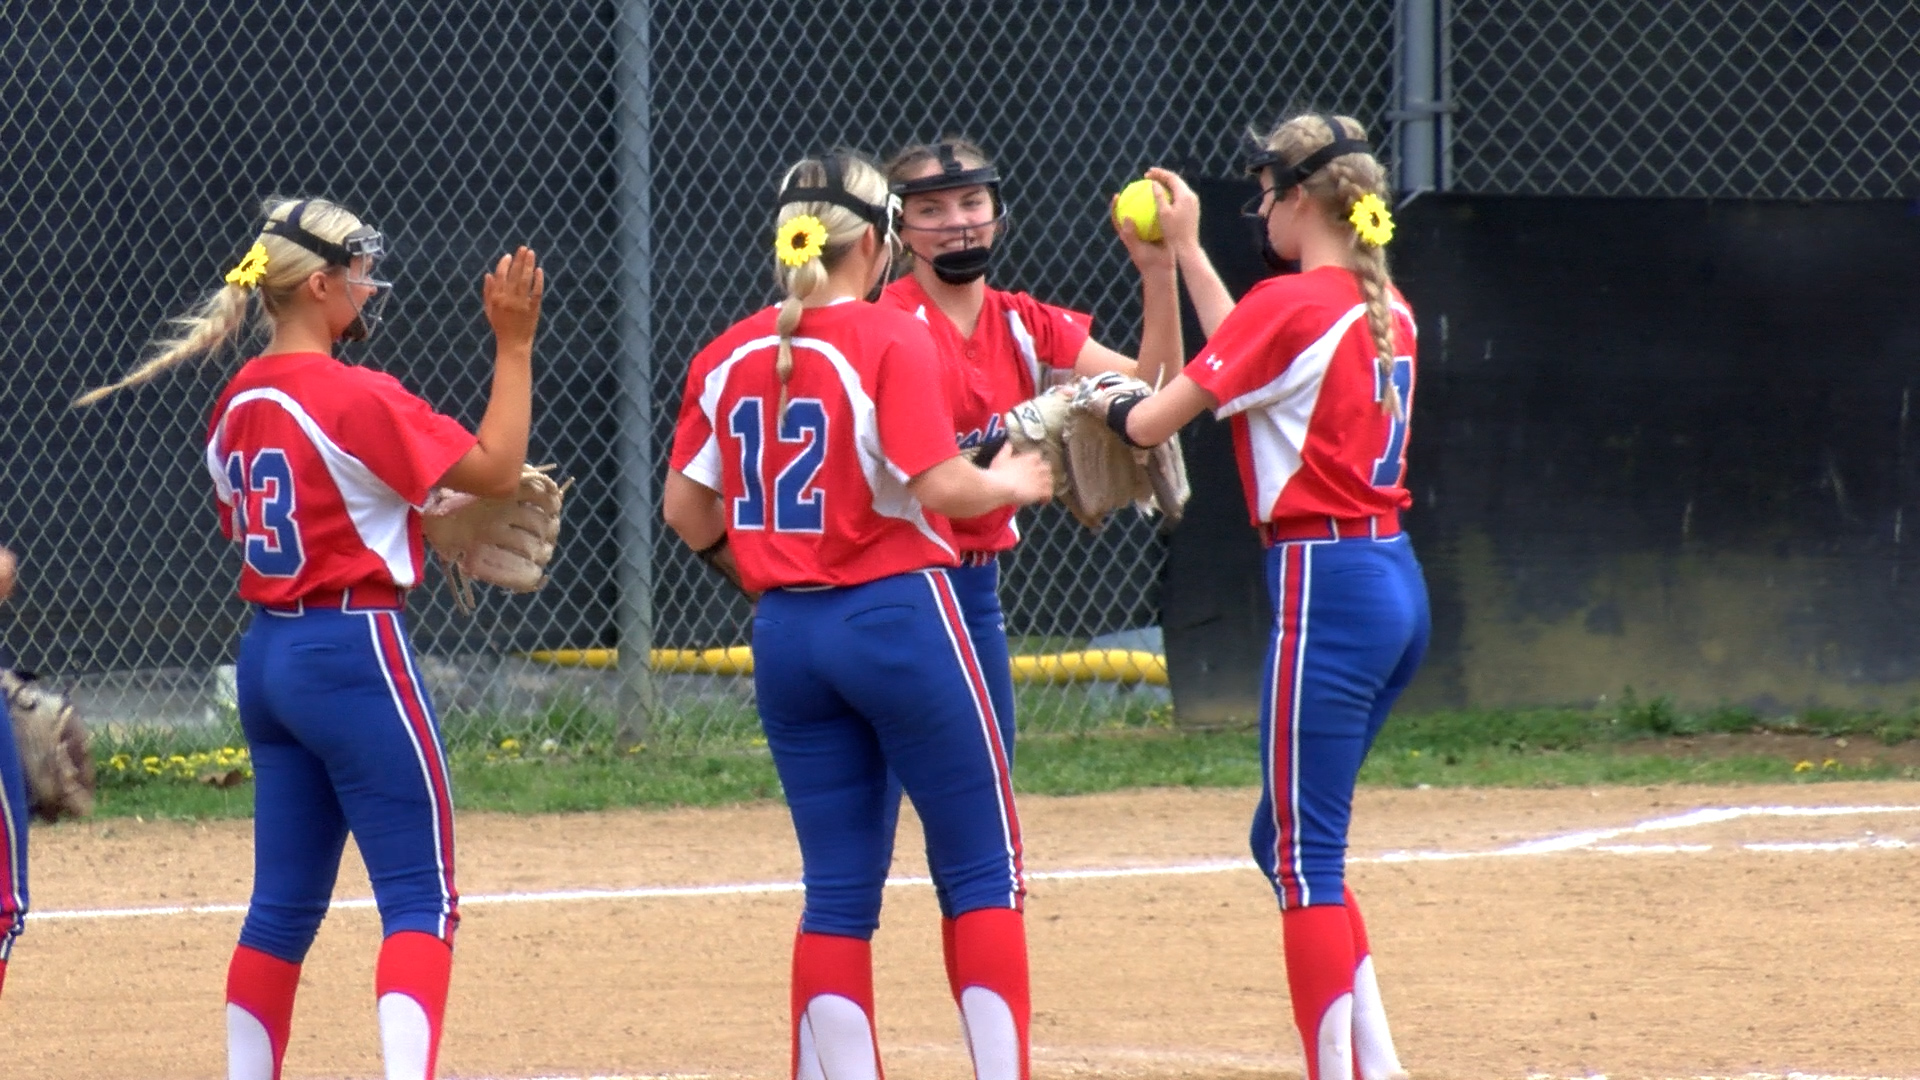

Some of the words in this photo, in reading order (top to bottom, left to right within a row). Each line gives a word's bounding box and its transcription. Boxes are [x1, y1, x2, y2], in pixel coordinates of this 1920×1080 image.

[728, 397, 830, 534] 12
[1370, 356, 1413, 488] 7
[225, 447, 307, 578] 13
